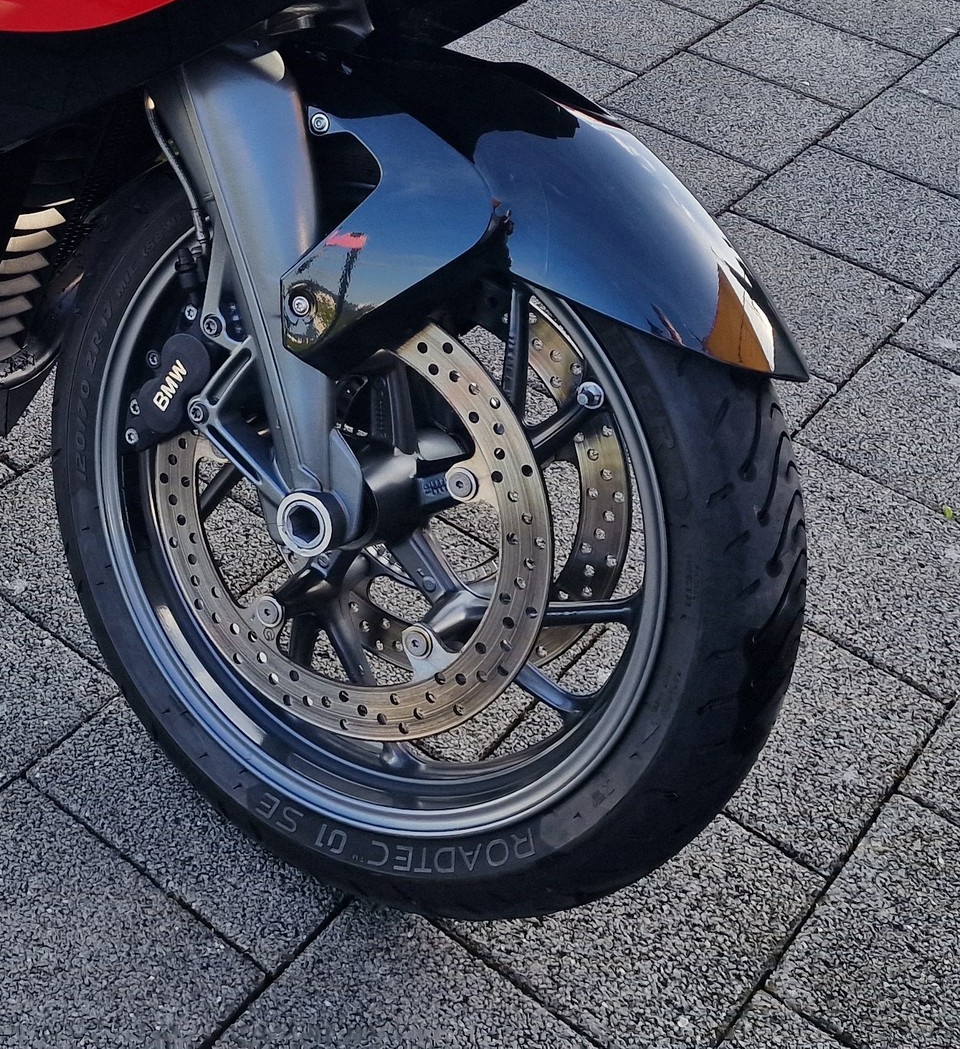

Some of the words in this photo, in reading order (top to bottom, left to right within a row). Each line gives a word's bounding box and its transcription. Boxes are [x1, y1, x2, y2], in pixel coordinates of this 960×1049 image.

[153, 359, 188, 412] BMW
[255, 792, 305, 833] SE
[314, 823, 348, 853] 01
